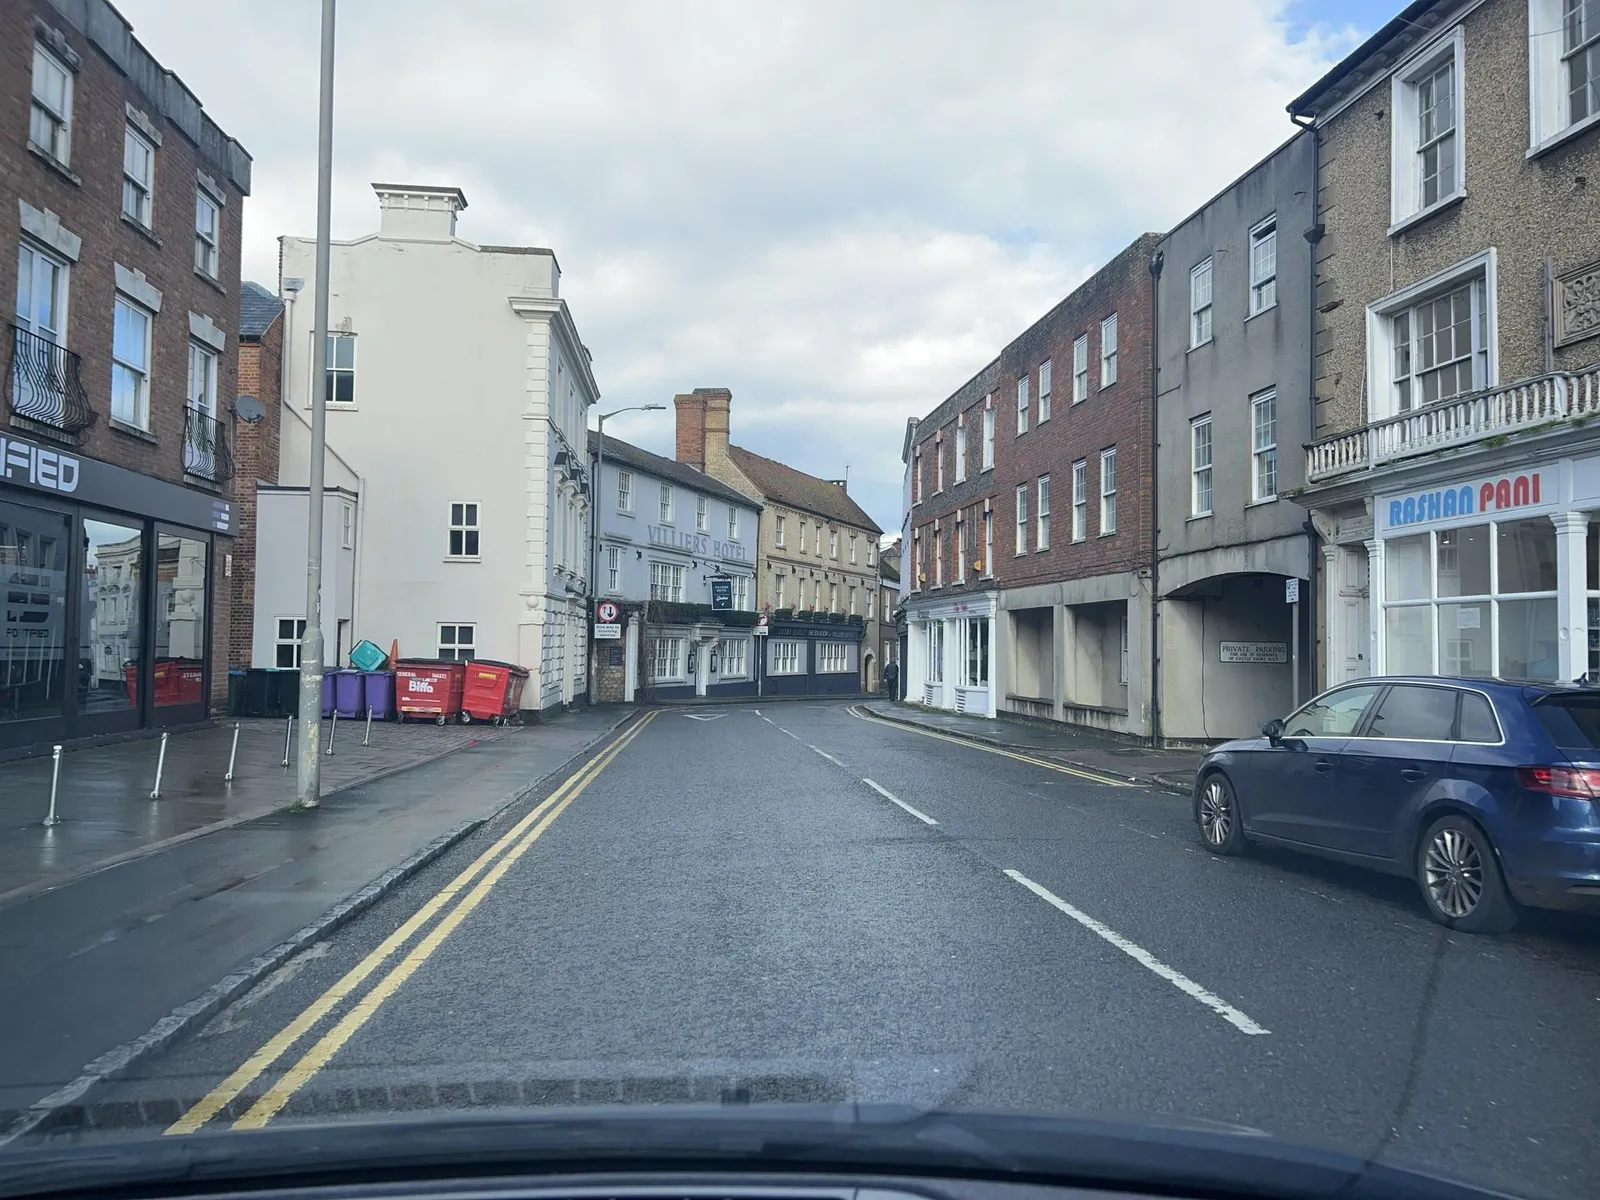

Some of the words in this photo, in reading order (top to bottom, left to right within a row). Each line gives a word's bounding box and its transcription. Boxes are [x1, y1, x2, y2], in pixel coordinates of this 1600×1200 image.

[1389, 485, 1474, 527] RASHAN
[1479, 473, 1541, 512] PANI
[647, 525, 707, 555] VILLIERS
[713, 540, 746, 561] HOTEL
[6, 628, 49, 638] FOTIFIED
[408, 680, 434, 693] Biffa
